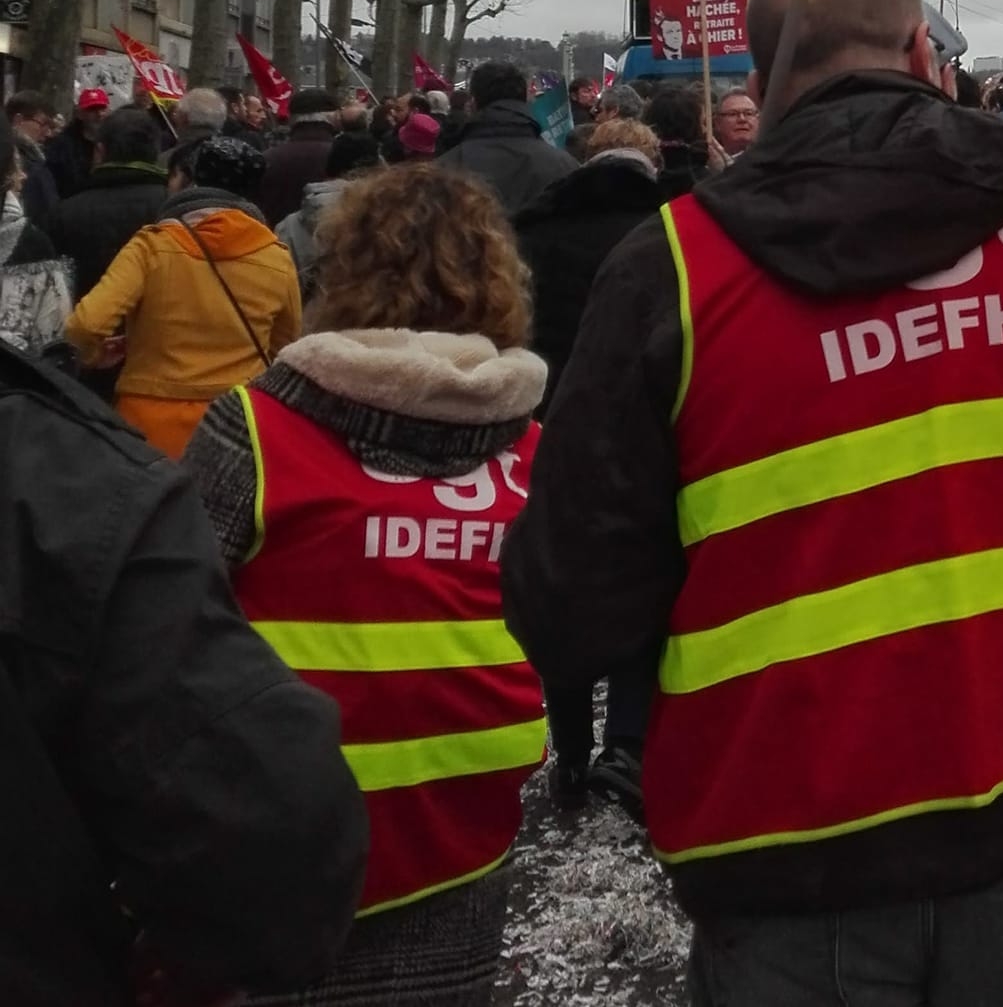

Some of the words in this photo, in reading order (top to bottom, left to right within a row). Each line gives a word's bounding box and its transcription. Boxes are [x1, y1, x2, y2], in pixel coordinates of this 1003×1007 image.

[694, 18, 735, 30] RTRAITE
[686, 30, 696, 45] À
[698, 29, 736, 43] HIER
